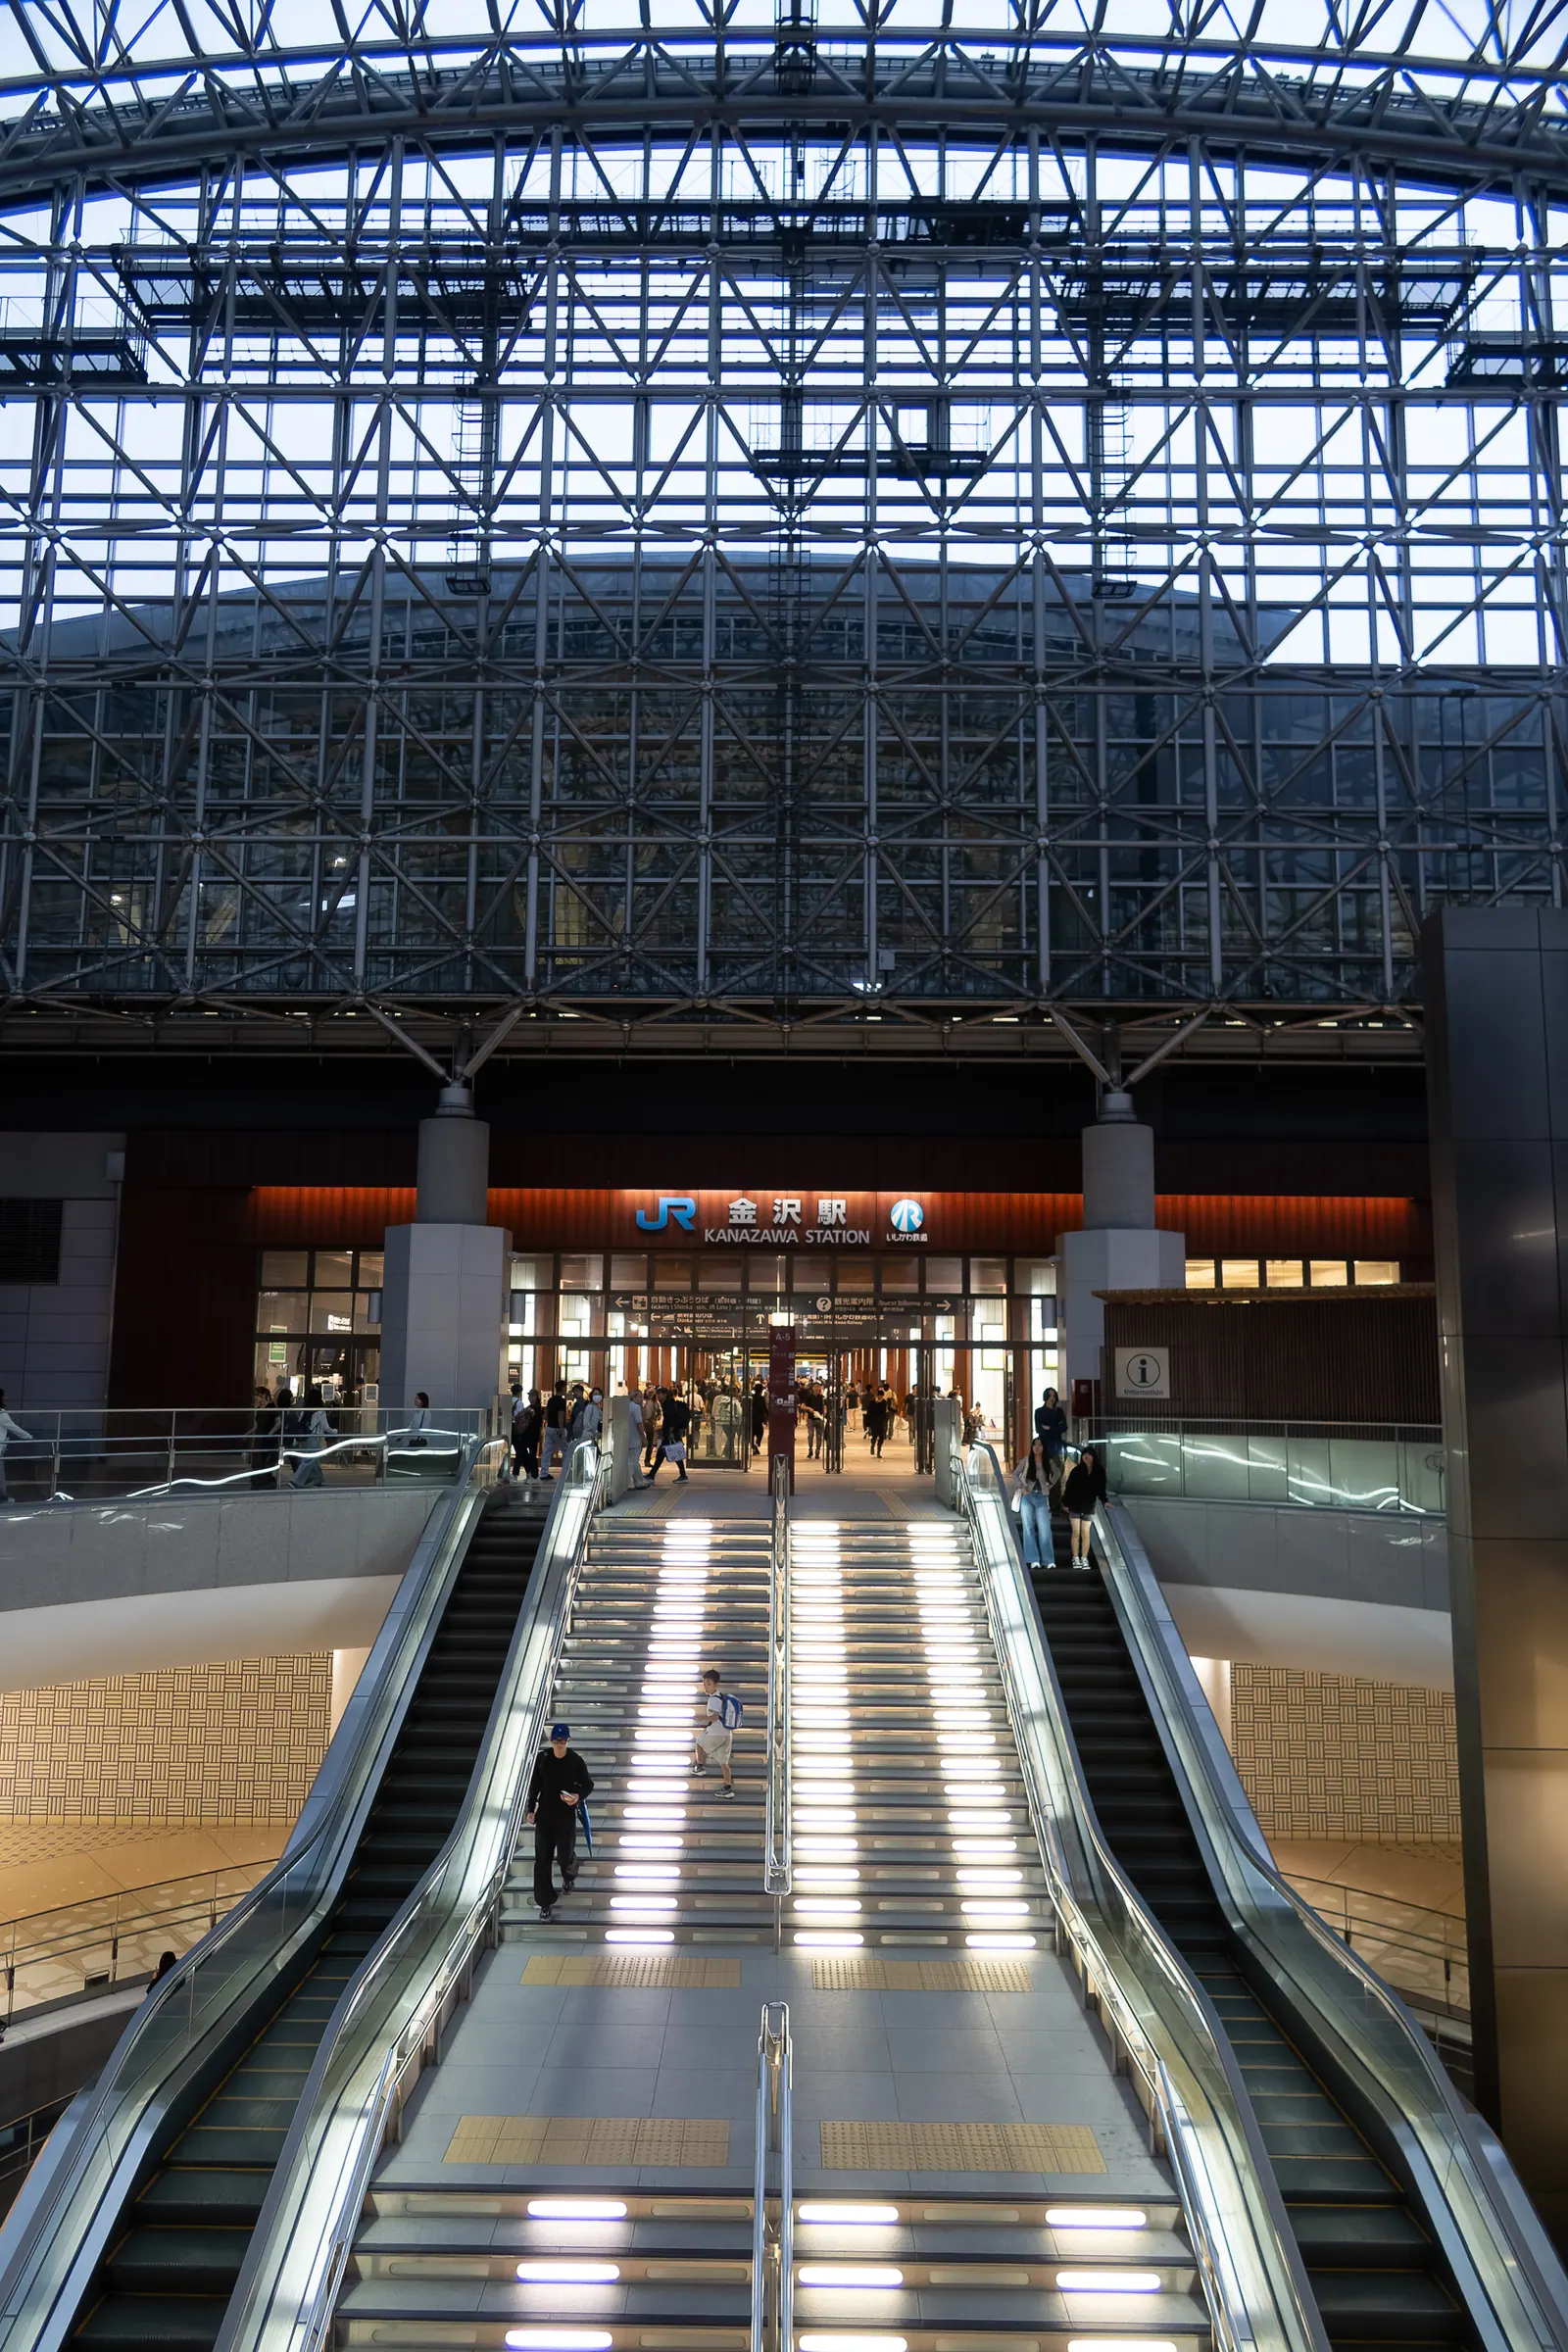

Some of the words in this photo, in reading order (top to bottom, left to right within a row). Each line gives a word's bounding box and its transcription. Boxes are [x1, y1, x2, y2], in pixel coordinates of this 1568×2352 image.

[636, 1197, 696, 1231] JR
[727, 1198, 847, 1226] 金沢駅
[705, 1229, 800, 1244] KANAZAWA
[806, 1229, 870, 1245] STATION
